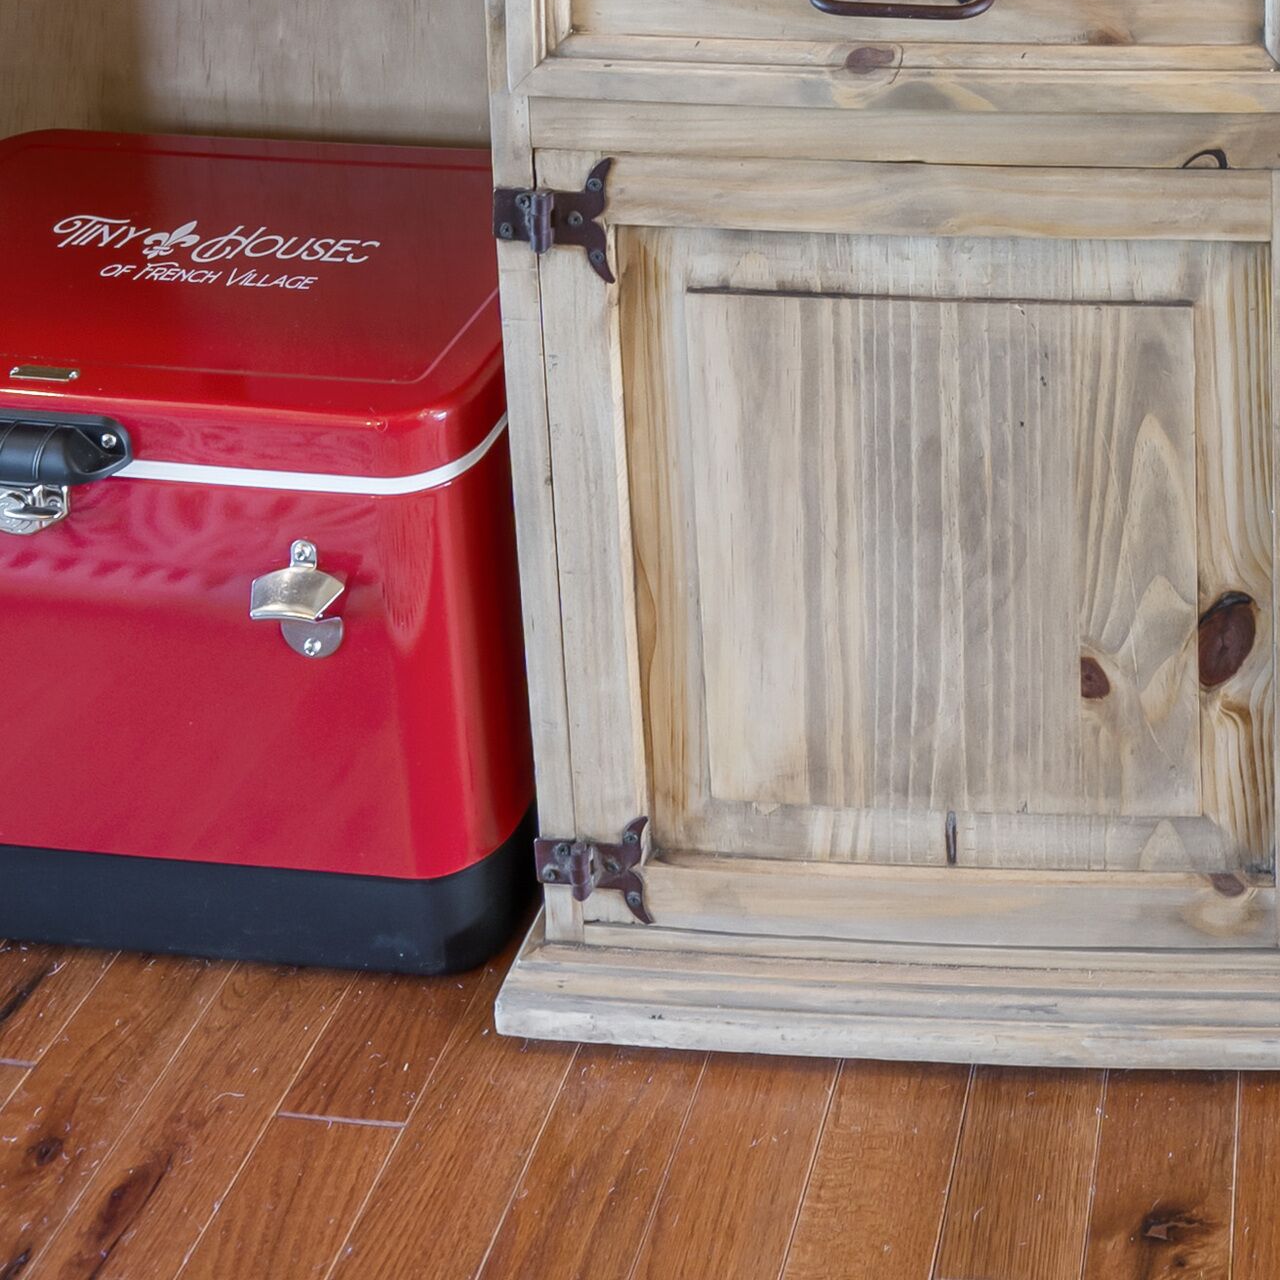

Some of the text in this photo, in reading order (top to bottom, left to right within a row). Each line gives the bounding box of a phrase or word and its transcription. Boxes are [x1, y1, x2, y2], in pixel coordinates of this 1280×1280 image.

[53, 215, 151, 248] TINY
[100, 262, 319, 290] OF FRENCH VILLAGE
